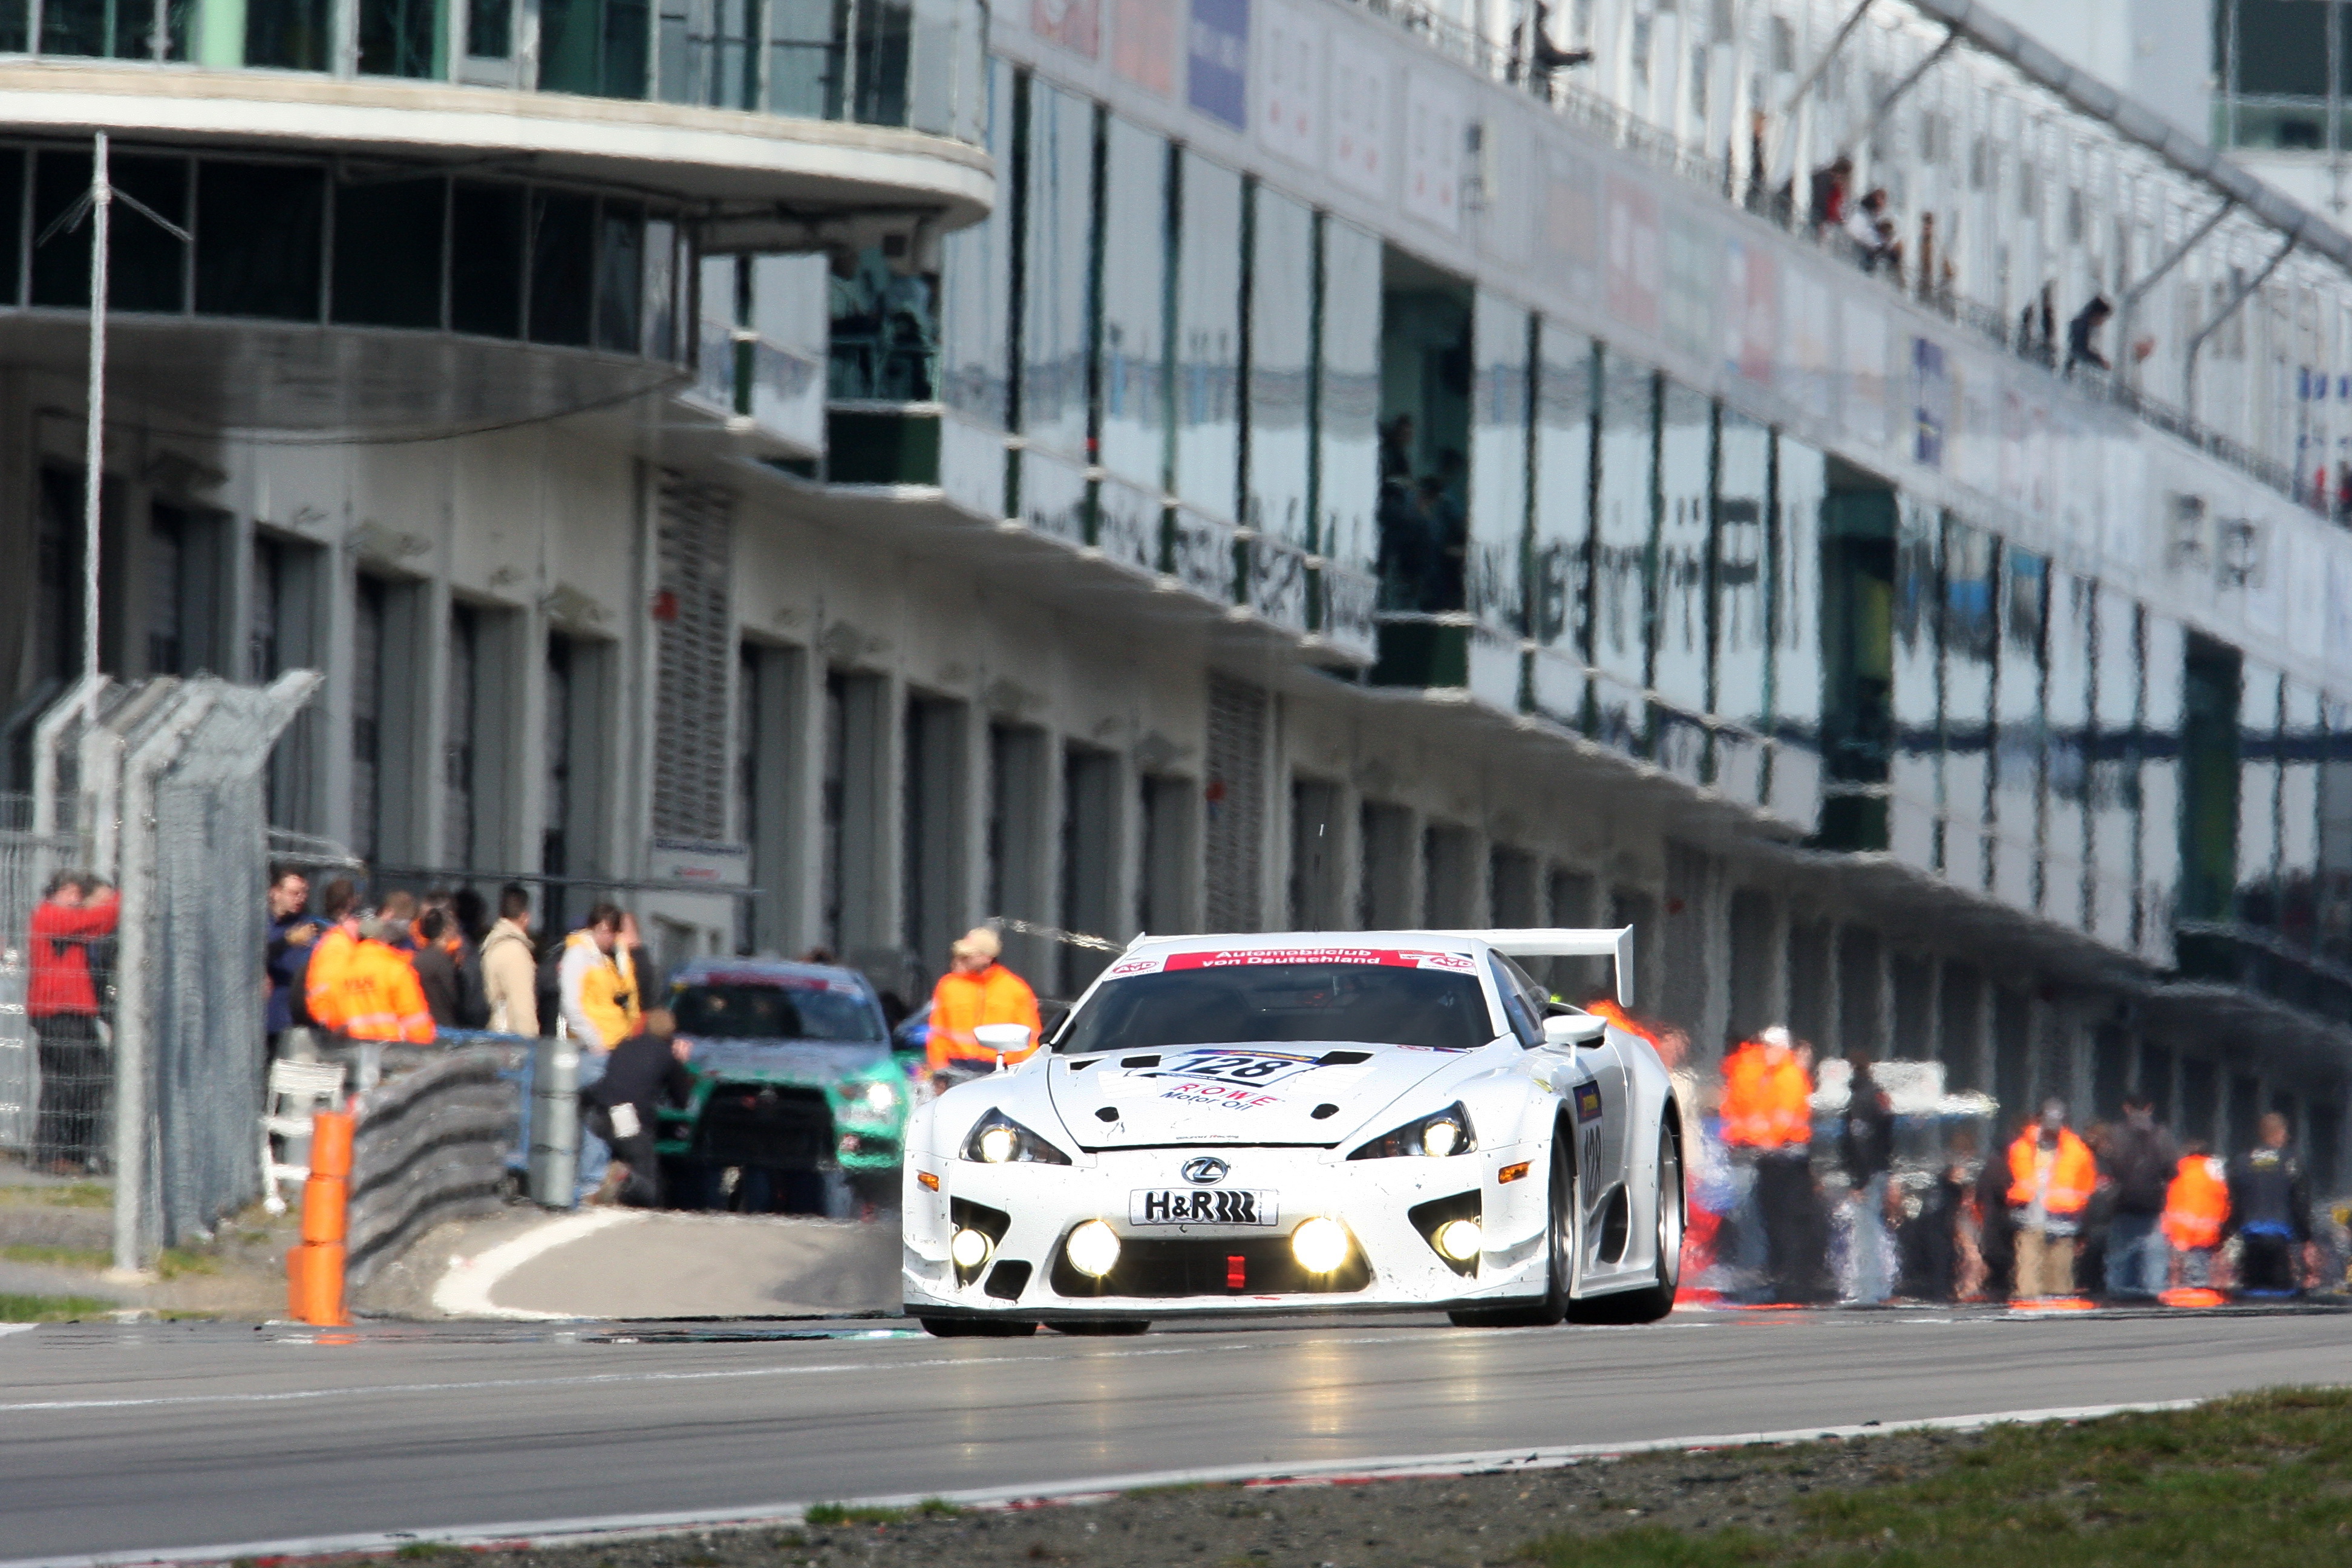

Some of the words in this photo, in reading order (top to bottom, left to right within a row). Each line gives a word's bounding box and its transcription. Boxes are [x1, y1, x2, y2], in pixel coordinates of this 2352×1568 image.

[1215, 949, 1372, 958] Automobilclub
[1169, 1056, 1293, 1077] 128
[1159, 1091, 1221, 1103] Motor
[1221, 1100, 1253, 1111] Oil
[1172, 1083, 1278, 1106] ROWE
